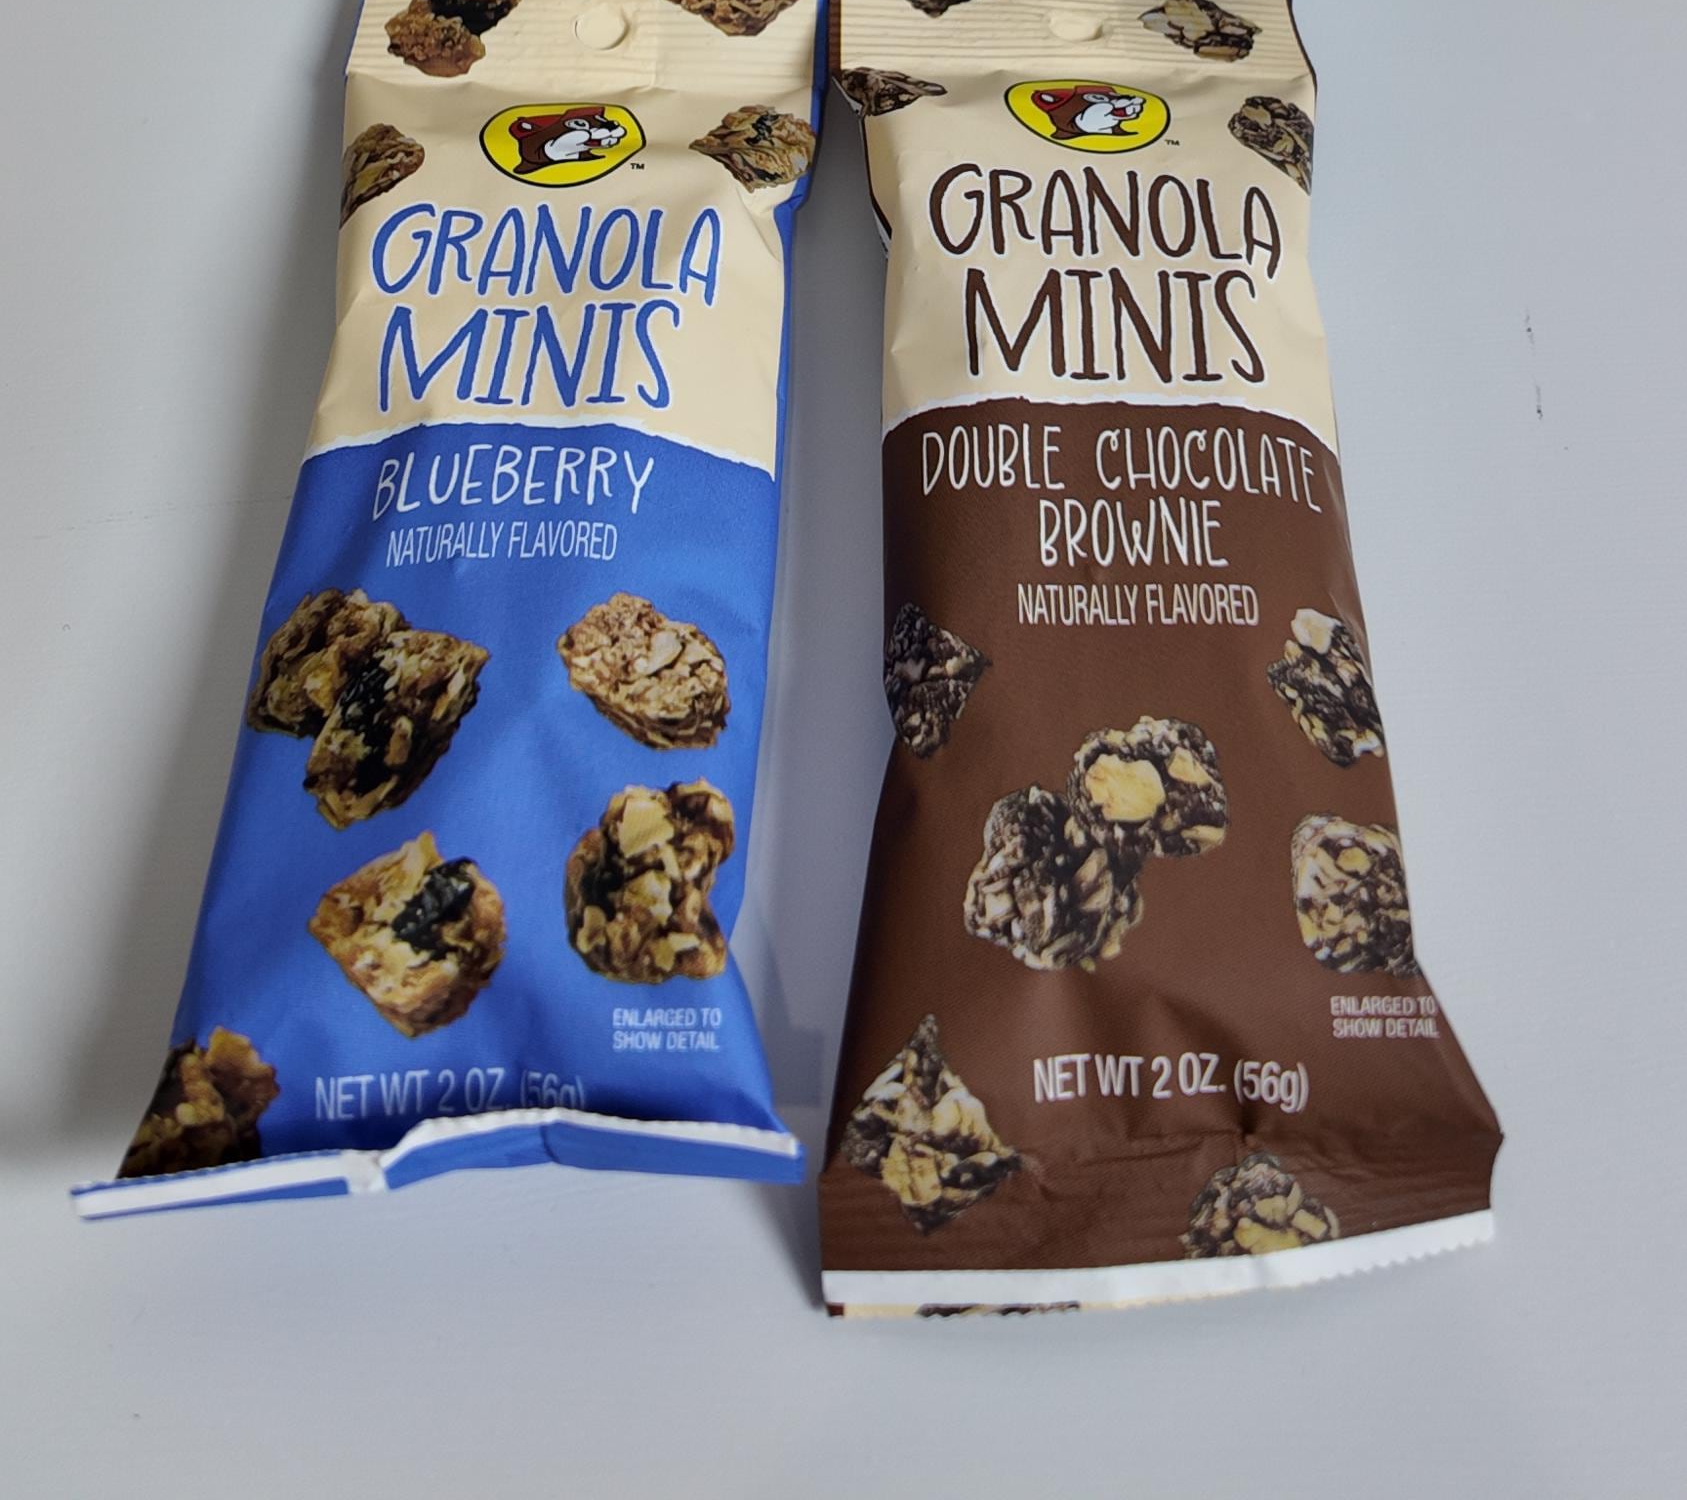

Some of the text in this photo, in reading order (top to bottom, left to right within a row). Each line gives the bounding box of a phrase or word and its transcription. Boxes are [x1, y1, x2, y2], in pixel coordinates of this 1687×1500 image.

[630, 162, 645, 170] TM
[1164, 139, 1180, 147] TM
[929, 162, 1281, 279] GRANOLA
[371, 203, 720, 306] GRANOLA
[965, 268, 1264, 383] MINIS
[379, 300, 680, 412] MINIS
[372, 443, 655, 521] BLUEBERRY
[922, 422, 1322, 513] DOUBLE CHOCOLATE
[386, 519, 618, 567] NATURALLY FLAVORED
[1039, 496, 1229, 567] BROWNIE
[1017, 582, 1260, 626] NATURALLY FLAVORED
[612, 1007, 722, 1029] ENLARGED TO
[1330, 995, 1437, 1016] ENLARGED TO
[1332, 1018, 1440, 1038] SHOW DETAIL
[612, 1030, 720, 1052] SHOW DETAIL
[314, 1074, 376, 1121] NET
[380, 1068, 430, 1116] WT
[437, 1068, 456, 1113] 2
[1033, 1051, 1310, 1114] NET WT 2 OZ. (56g)
